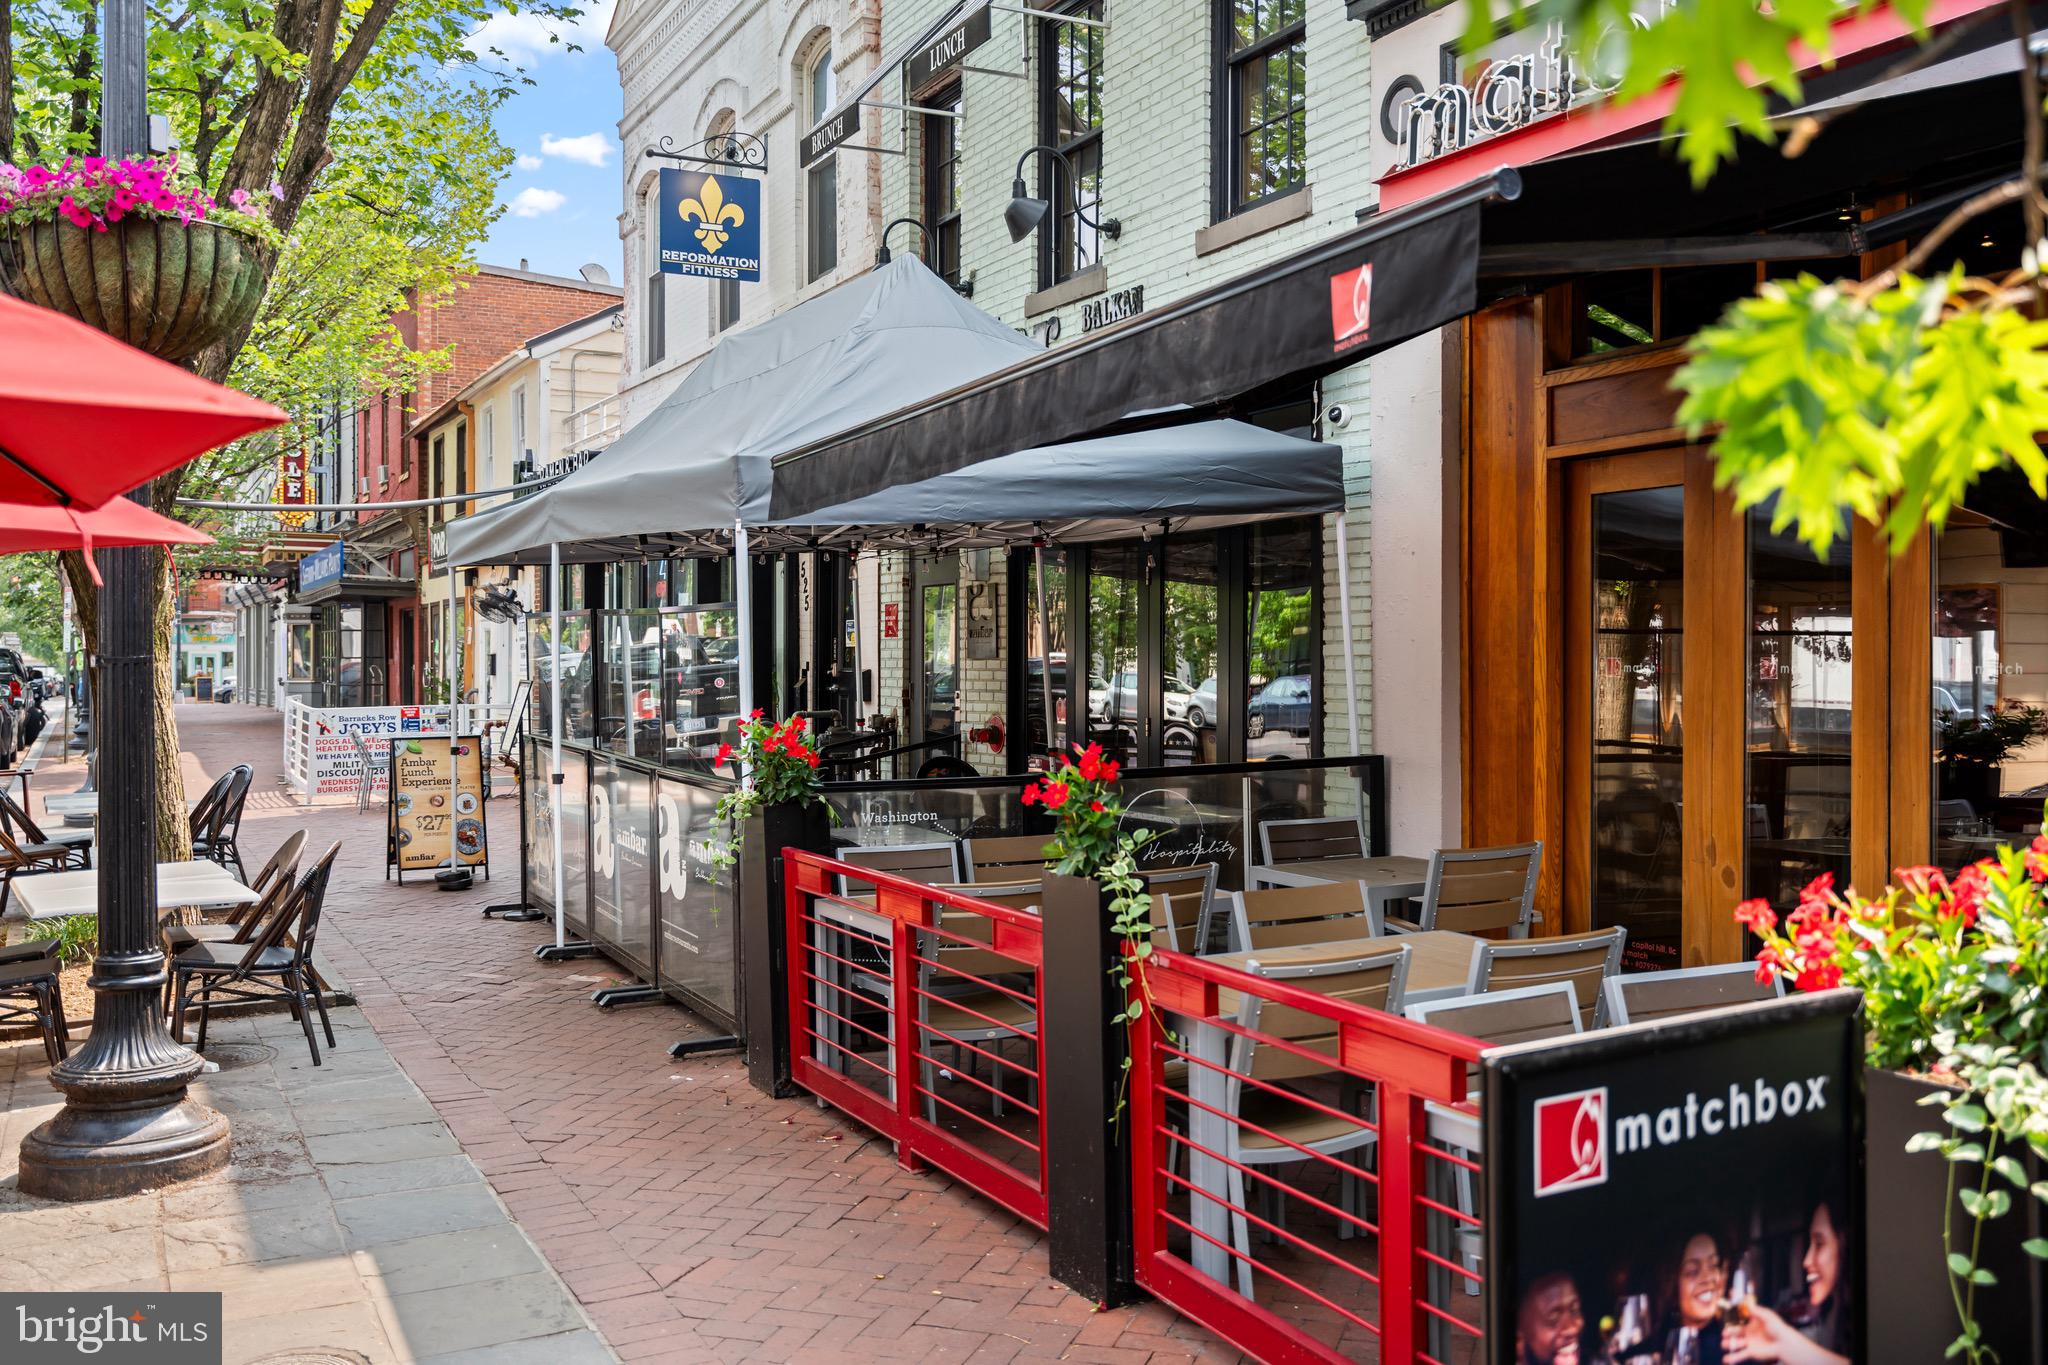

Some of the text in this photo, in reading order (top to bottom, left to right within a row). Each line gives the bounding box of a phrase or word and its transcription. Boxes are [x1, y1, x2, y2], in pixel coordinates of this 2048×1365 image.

[929, 26, 966, 72] LUNCH
[811, 115, 844, 155] BRUNCH
[662, 249, 758, 268] REFORMATION
[682, 264, 738, 278] FITNESS
[1081, 284, 1144, 332] BALKAN
[800, 561, 809, 612] 525
[338, 714, 376, 722] Barracks
[338, 722, 397, 735] JOEY'S
[315, 738, 340, 746] DOGS
[341, 737, 382, 745] ALWED
[400, 757, 437, 767] Ambar
[401, 766, 434, 777] Lunch
[320, 777, 377, 786] WEDNESDS
[861, 810, 938, 824] Washington
[1143, 840, 1237, 865] Hospitality
[1616, 1075, 1827, 1155] matchbox
